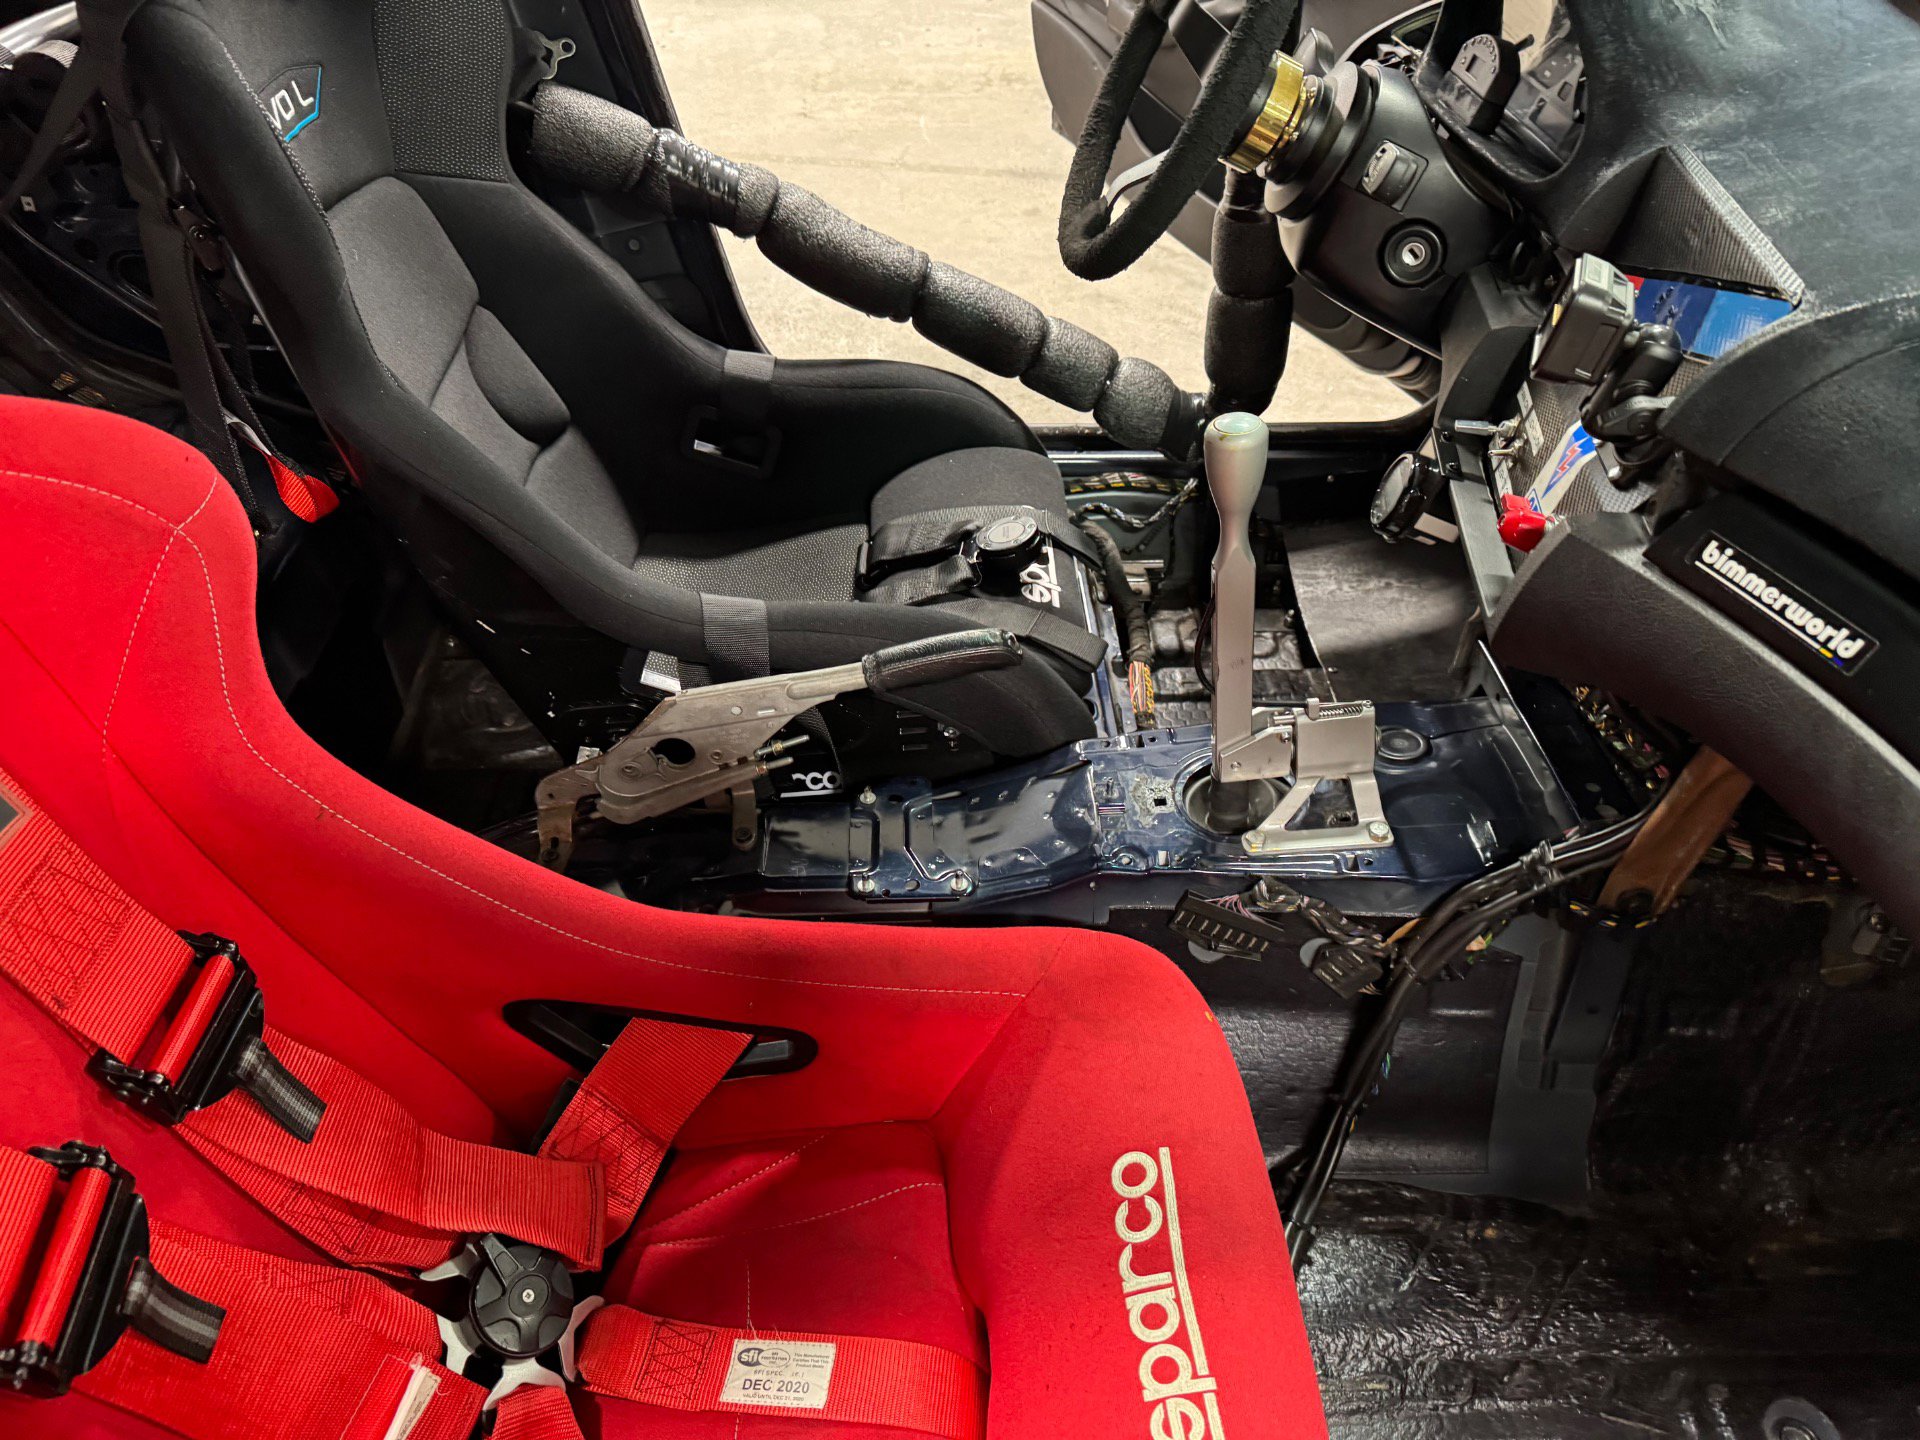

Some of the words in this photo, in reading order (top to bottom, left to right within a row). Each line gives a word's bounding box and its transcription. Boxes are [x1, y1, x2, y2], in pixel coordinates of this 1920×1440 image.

[1702, 540, 1865, 659] bimmerworld
[1111, 1151, 1218, 1440] sparco
[742, 1379, 773, 1391] DEC
[776, 1380, 810, 1394] 2020
